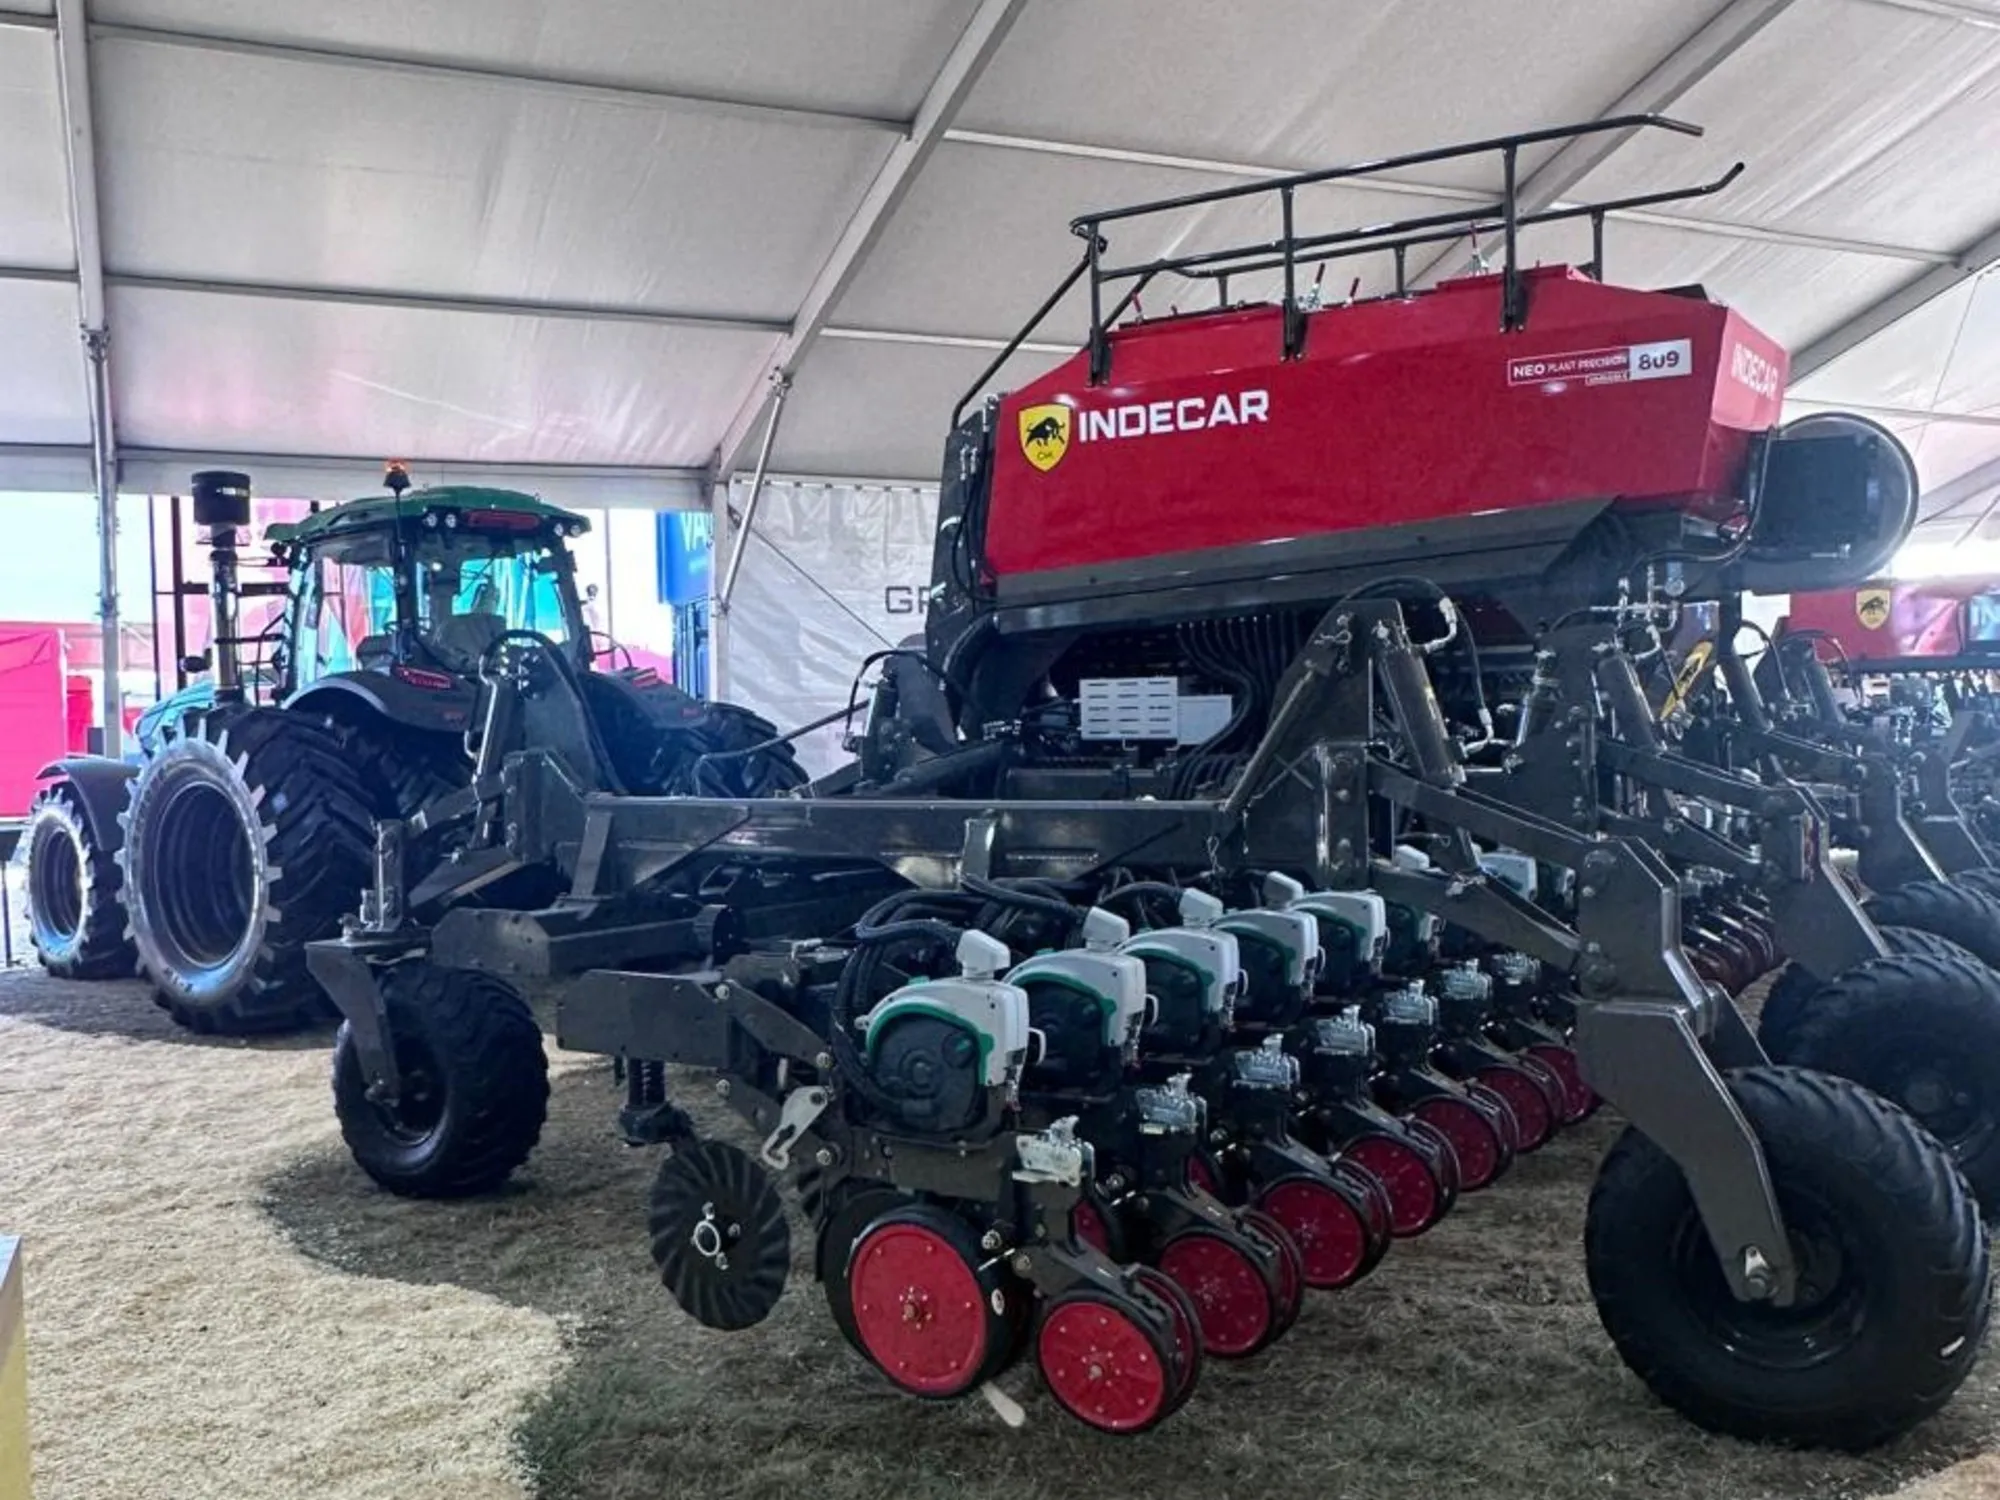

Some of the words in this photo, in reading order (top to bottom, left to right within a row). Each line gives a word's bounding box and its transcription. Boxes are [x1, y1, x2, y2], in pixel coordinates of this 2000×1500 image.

[1513, 364, 1545, 378] NEO
[1547, 360, 1577, 372] PLANT
[1578, 355, 1628, 369] PRECISION
[1079, 390, 1269, 443] INDECAR
